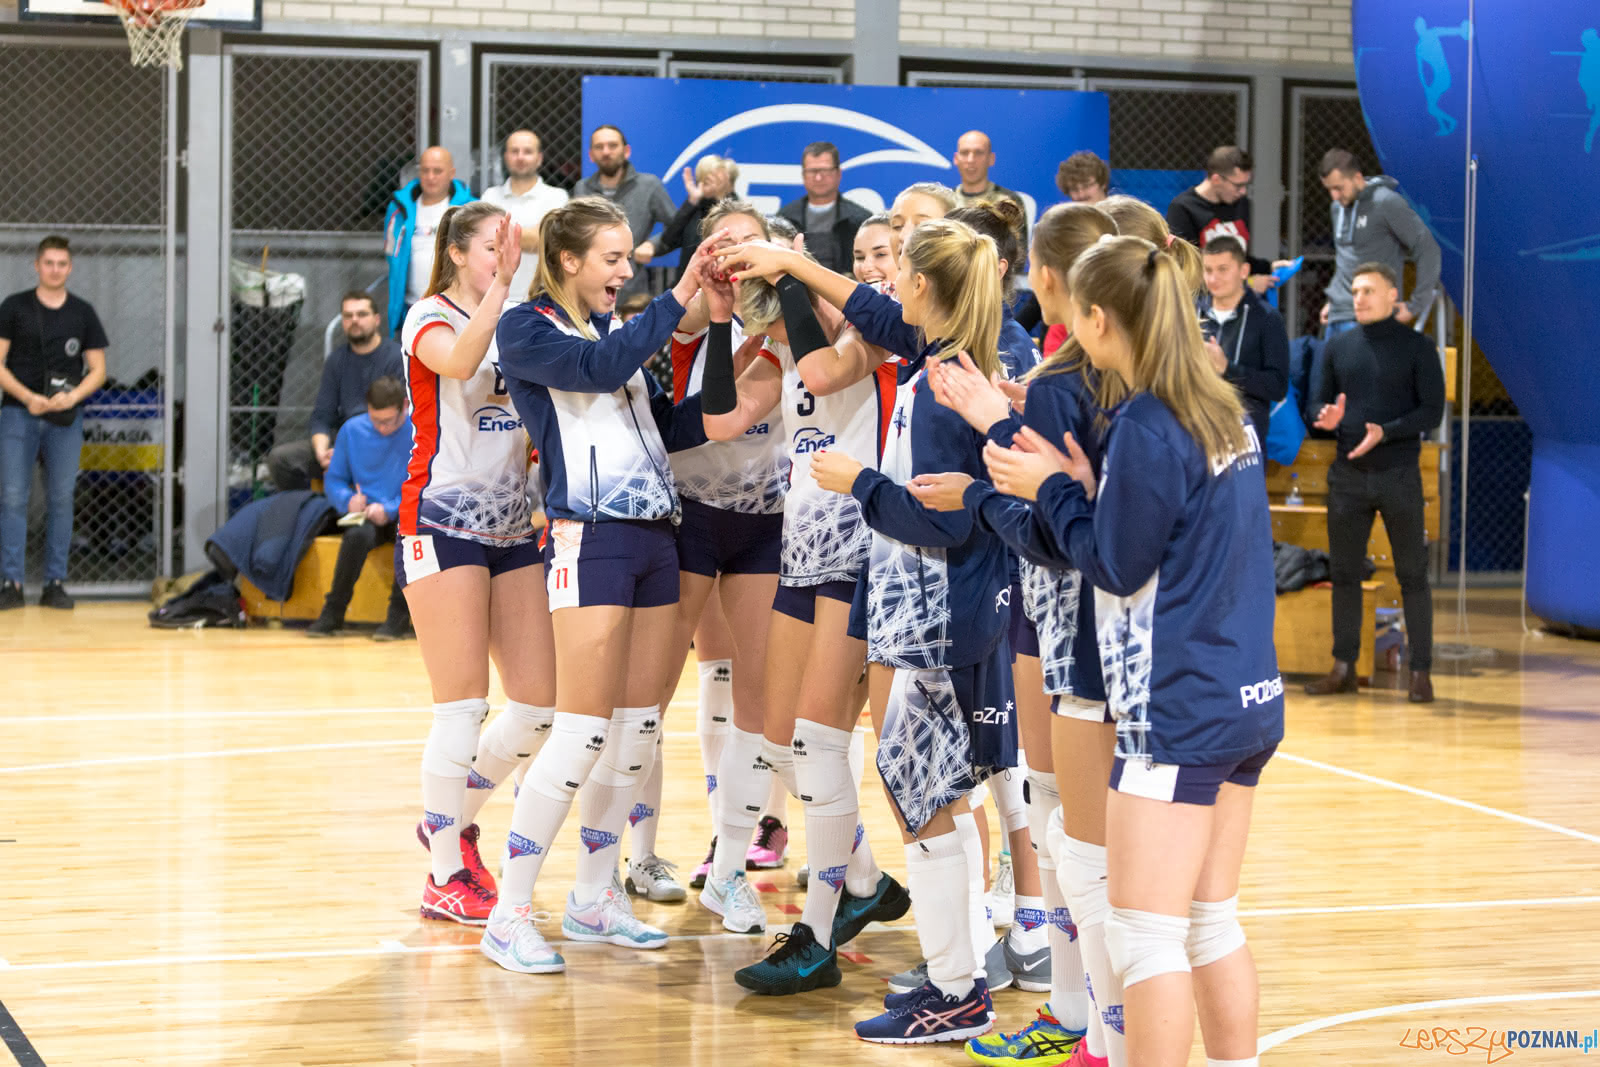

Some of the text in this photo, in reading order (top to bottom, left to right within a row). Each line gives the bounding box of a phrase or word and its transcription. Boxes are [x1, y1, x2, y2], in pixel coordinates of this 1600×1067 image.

[797, 381, 815, 416] 3
[745, 423, 769, 434] ea
[412, 540, 424, 561] 8
[556, 567, 568, 590] 11
